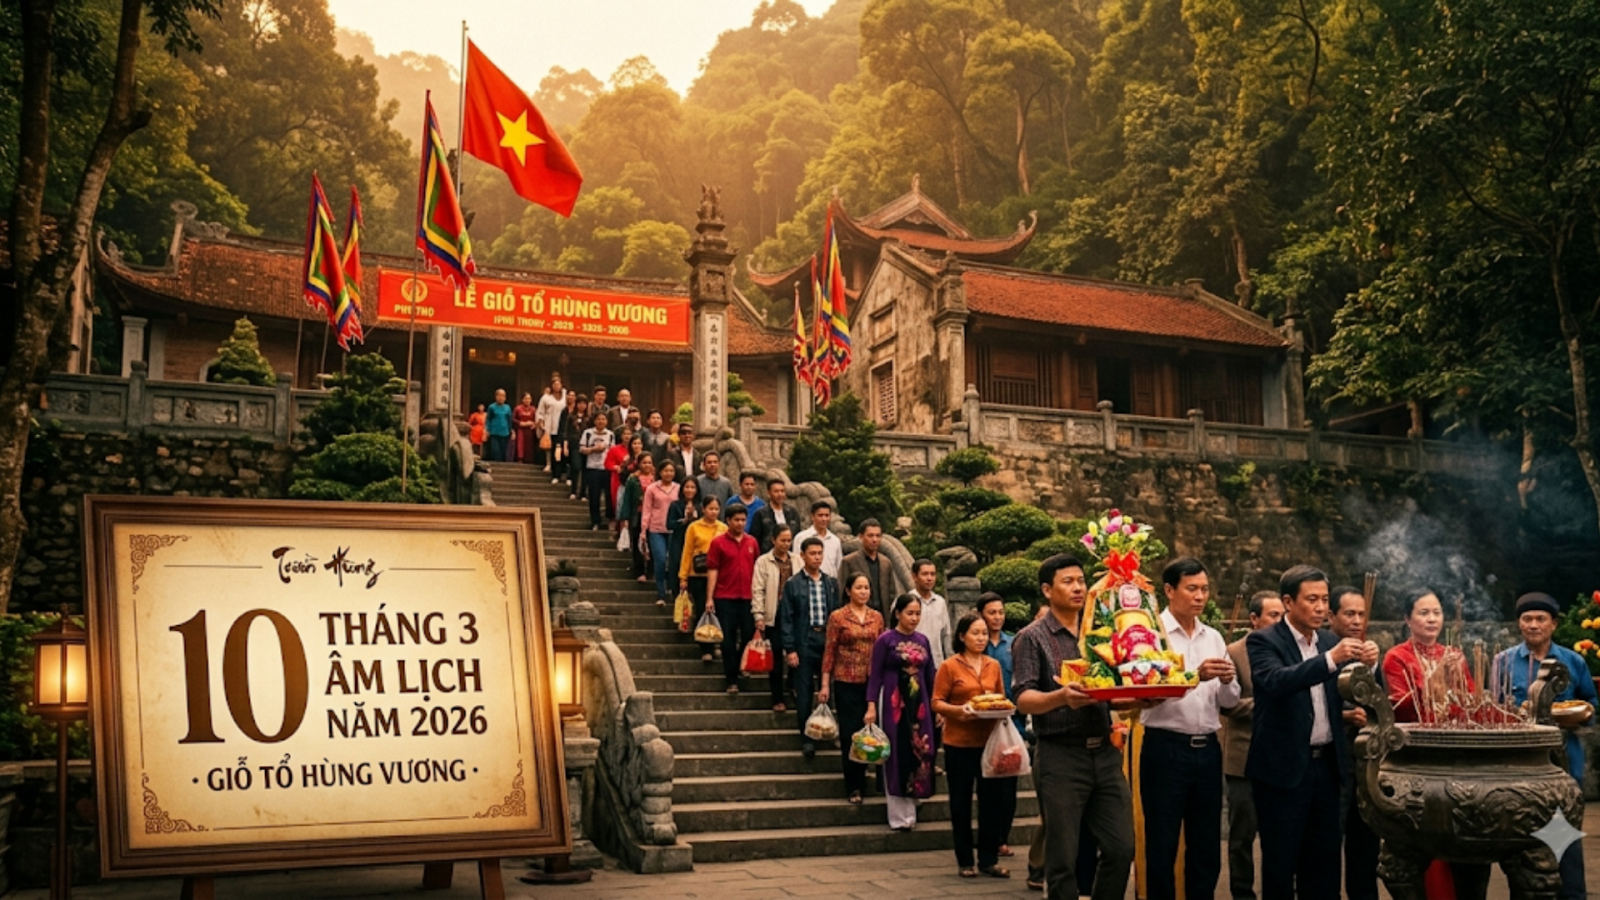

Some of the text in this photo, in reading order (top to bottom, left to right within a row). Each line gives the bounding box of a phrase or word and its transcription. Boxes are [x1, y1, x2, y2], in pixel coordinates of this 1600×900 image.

[482, 287, 516, 312] GIỖ
[520, 289, 546, 315] TỔ
[549, 295, 602, 320] HÙNG
[606, 302, 668, 325] VƯƠNG
[318, 603, 480, 646] THÁNG 3
[168, 608, 309, 745] 10
[324, 649, 483, 702] ÂM LỊCH
[327, 700, 488, 739] NĂM 2026
[207, 753, 466, 792] GIỖ TỔ HÙNG VƯƠNG
